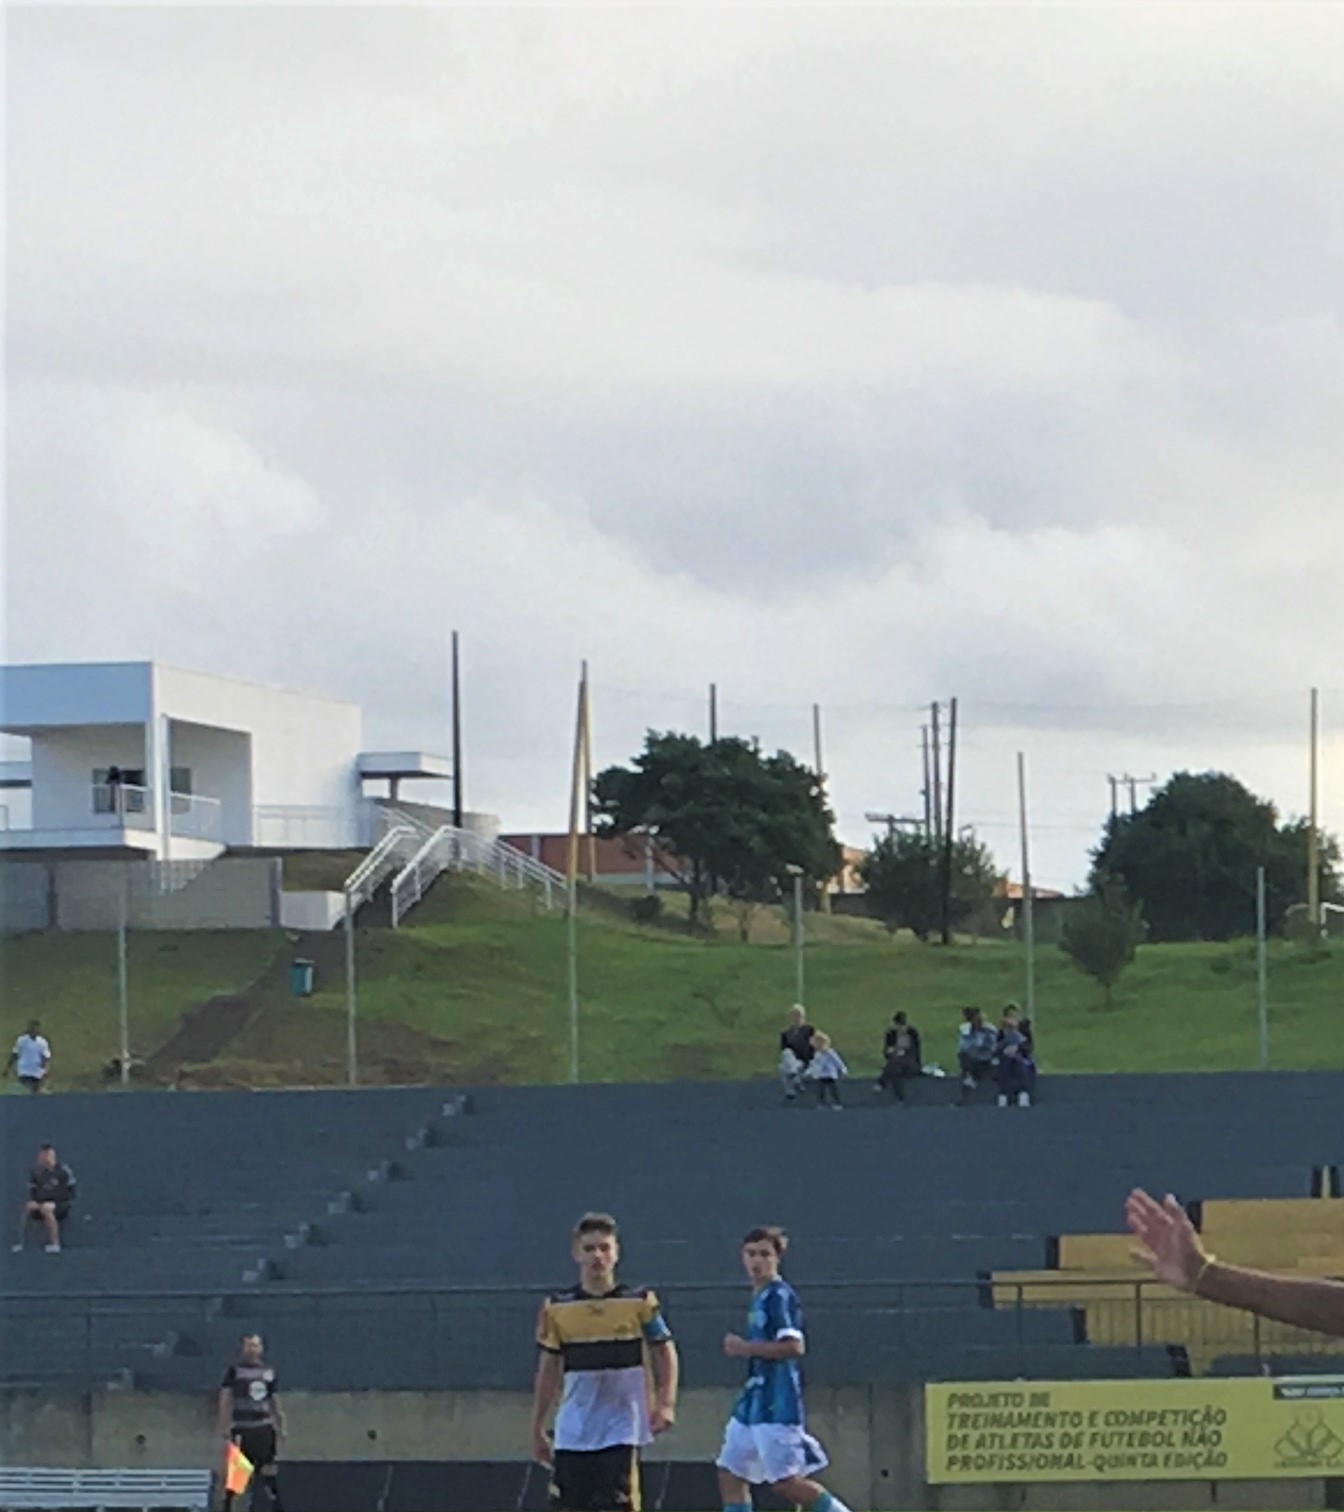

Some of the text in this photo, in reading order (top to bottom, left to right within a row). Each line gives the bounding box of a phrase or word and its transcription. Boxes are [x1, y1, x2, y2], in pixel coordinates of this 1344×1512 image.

[947, 1391, 1051, 1409] PROJETO DE
[947, 1404, 1227, 1429] TREINAMENTO E COMPETIÇÃO
[946, 1423, 1222, 1451] DE ATLETAS DE FUTEBOL NÃO
[1163, 1448, 1228, 1470] EDIÇÃO
